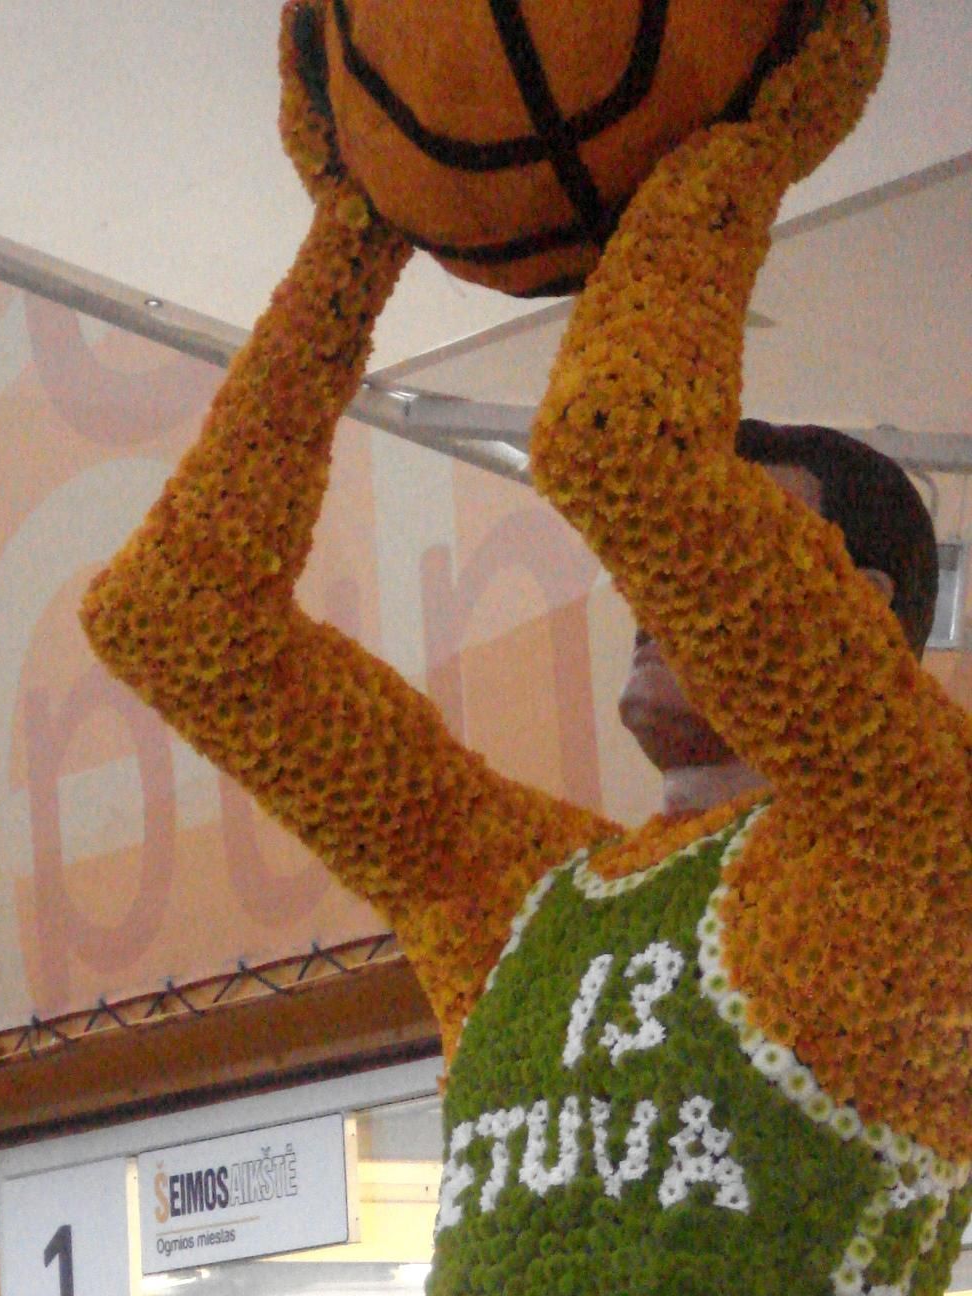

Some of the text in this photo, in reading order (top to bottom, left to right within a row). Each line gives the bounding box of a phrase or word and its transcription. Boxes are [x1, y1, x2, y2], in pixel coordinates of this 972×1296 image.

[562, 940, 684, 1068] 13
[156, 1228, 236, 1256] Ogmios miestas
